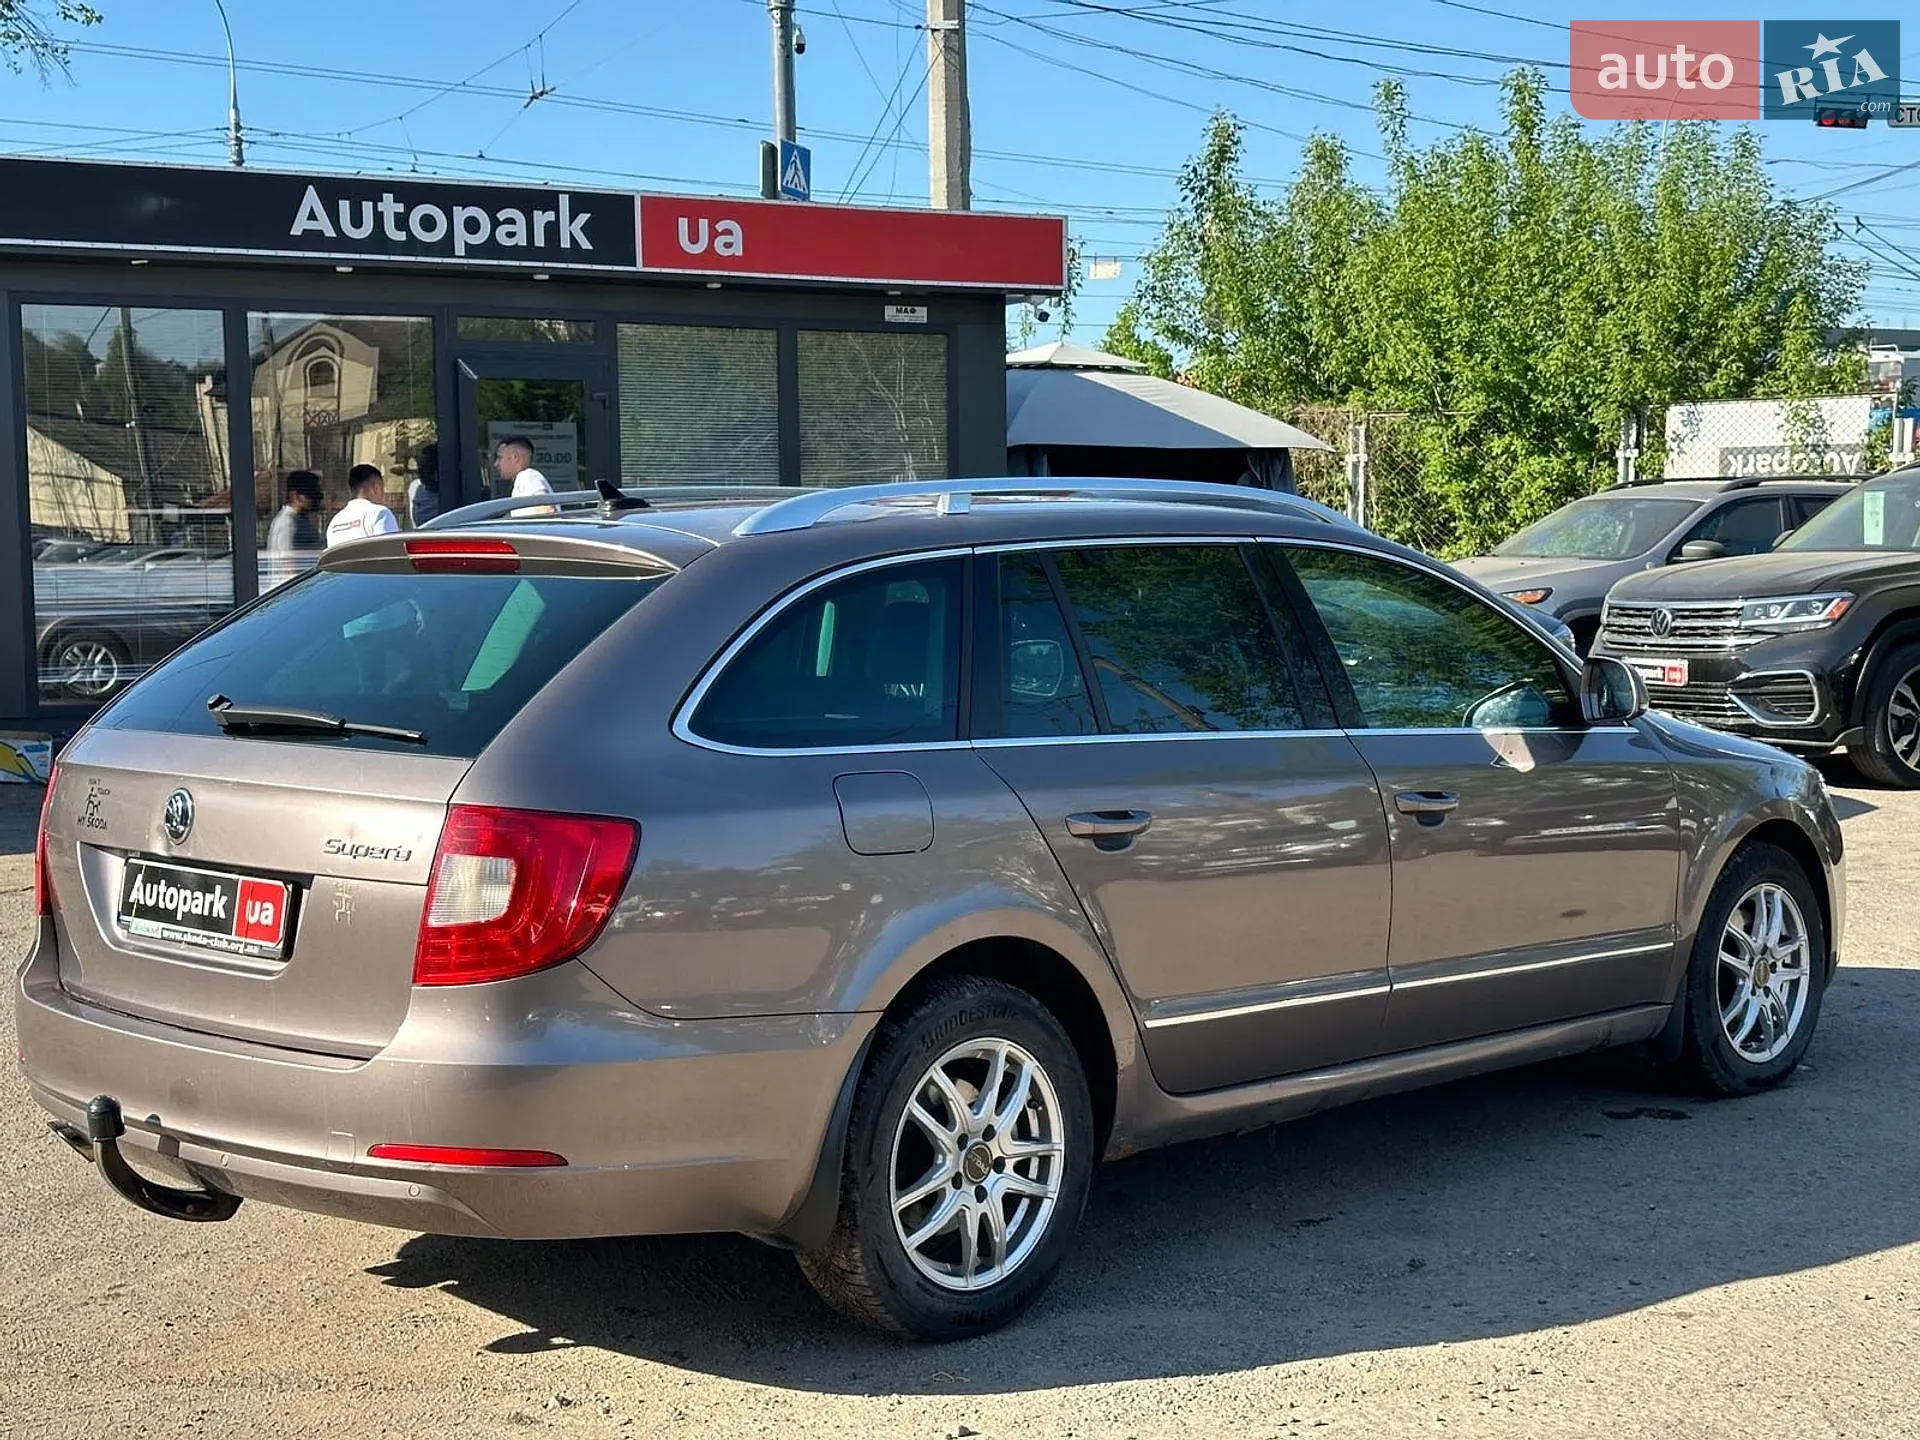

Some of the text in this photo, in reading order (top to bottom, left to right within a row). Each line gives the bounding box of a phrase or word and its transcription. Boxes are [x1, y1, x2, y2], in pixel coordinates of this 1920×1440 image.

[289, 184, 744, 257] Autopark ua
[1728, 447, 1861, 477] Auopark
[129, 873, 274, 927] Autopark ua
